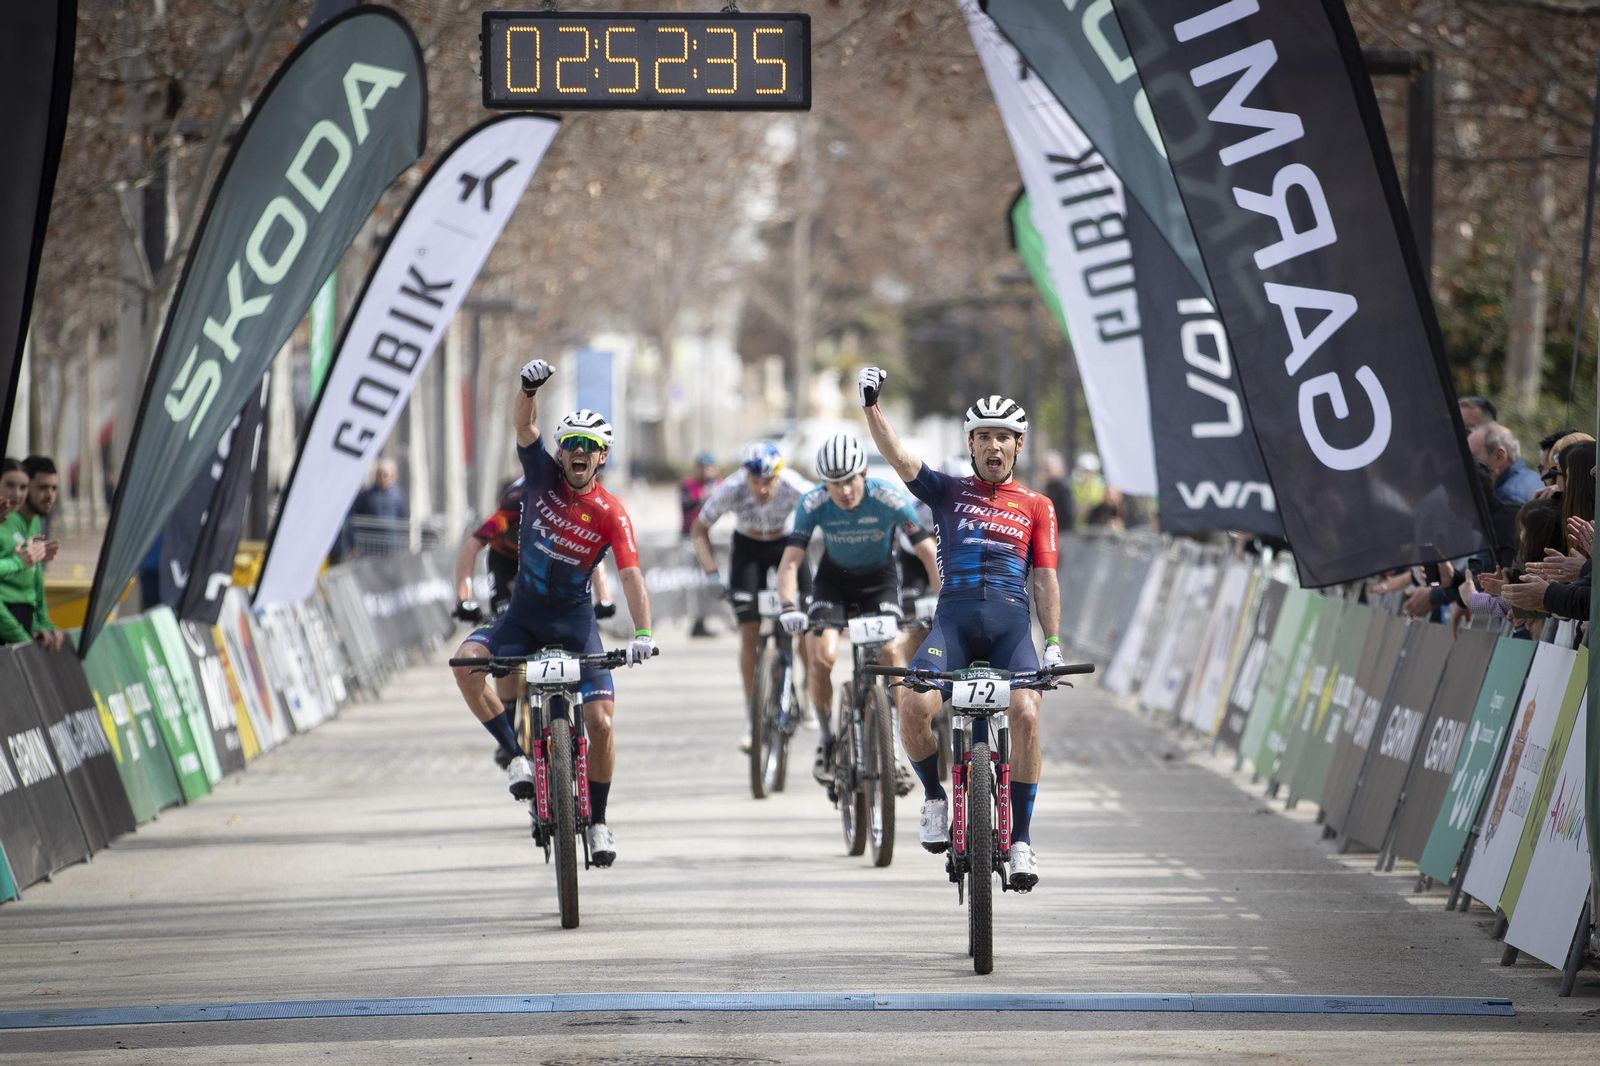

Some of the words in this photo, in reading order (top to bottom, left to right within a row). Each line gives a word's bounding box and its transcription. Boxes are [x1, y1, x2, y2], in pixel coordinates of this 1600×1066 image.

[506, 26, 787, 94] 02:52:35
[332, 263, 455, 459] GOBIK
[535, 496, 602, 544] TORPADO
[953, 502, 1032, 527] TORPADO
[977, 520, 1025, 541] KENDA
[549, 532, 593, 555] KENDA
[863, 619, 885, 638] 1-2
[540, 660, 565, 679] 7-1
[967, 681, 996, 704] 7-2
[536, 757, 549, 814] MANITOU
[577, 755, 589, 812] MANITOU
[954, 784, 965, 845] MANITOU
[999, 784, 1010, 845] MANITOU
